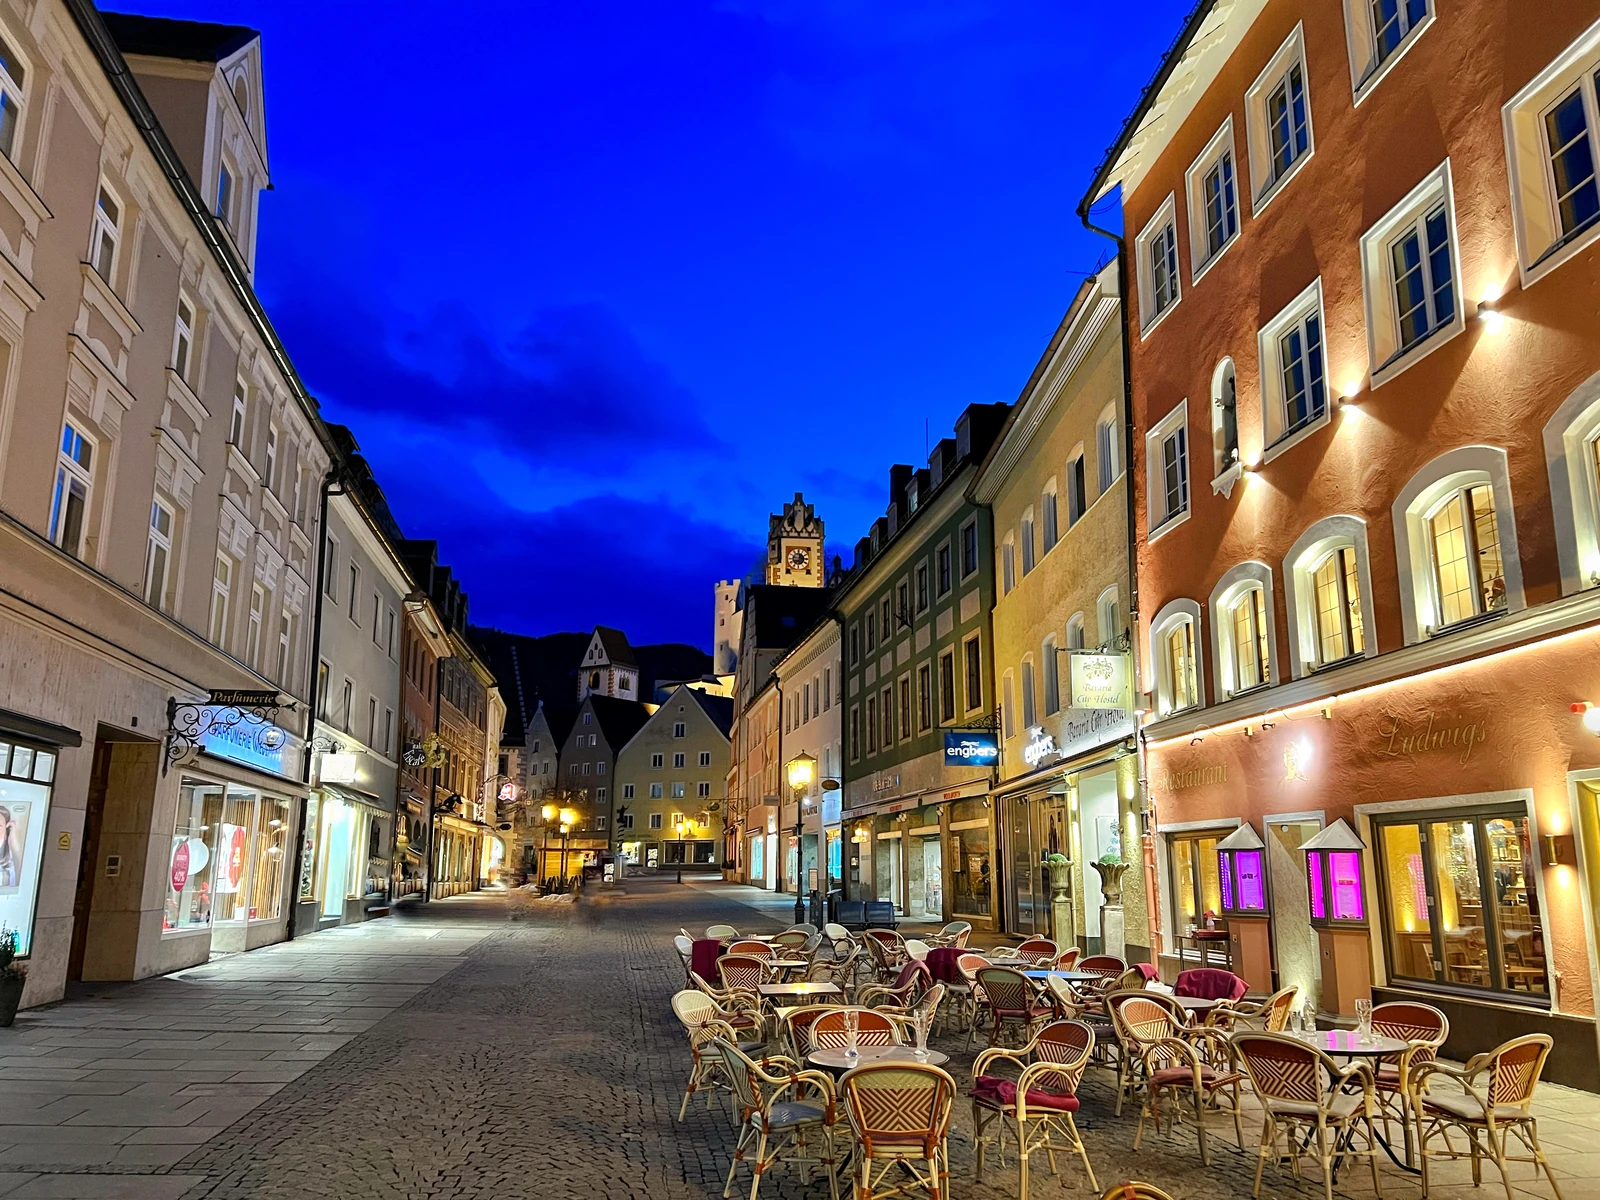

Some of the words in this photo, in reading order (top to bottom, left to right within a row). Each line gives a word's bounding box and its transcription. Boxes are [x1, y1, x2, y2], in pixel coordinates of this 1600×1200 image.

[1083, 683, 1112, 692] Bavaria
[212, 691, 274, 704] Parfümerie
[1076, 693, 1092, 707] City
[1094, 692, 1121, 704] Hostel
[1377, 712, 1487, 765] Ludwigs
[947, 745, 998, 758] engbers
[1025, 735, 1053, 766] engbers
[1158, 761, 1229, 792] Restaurant
